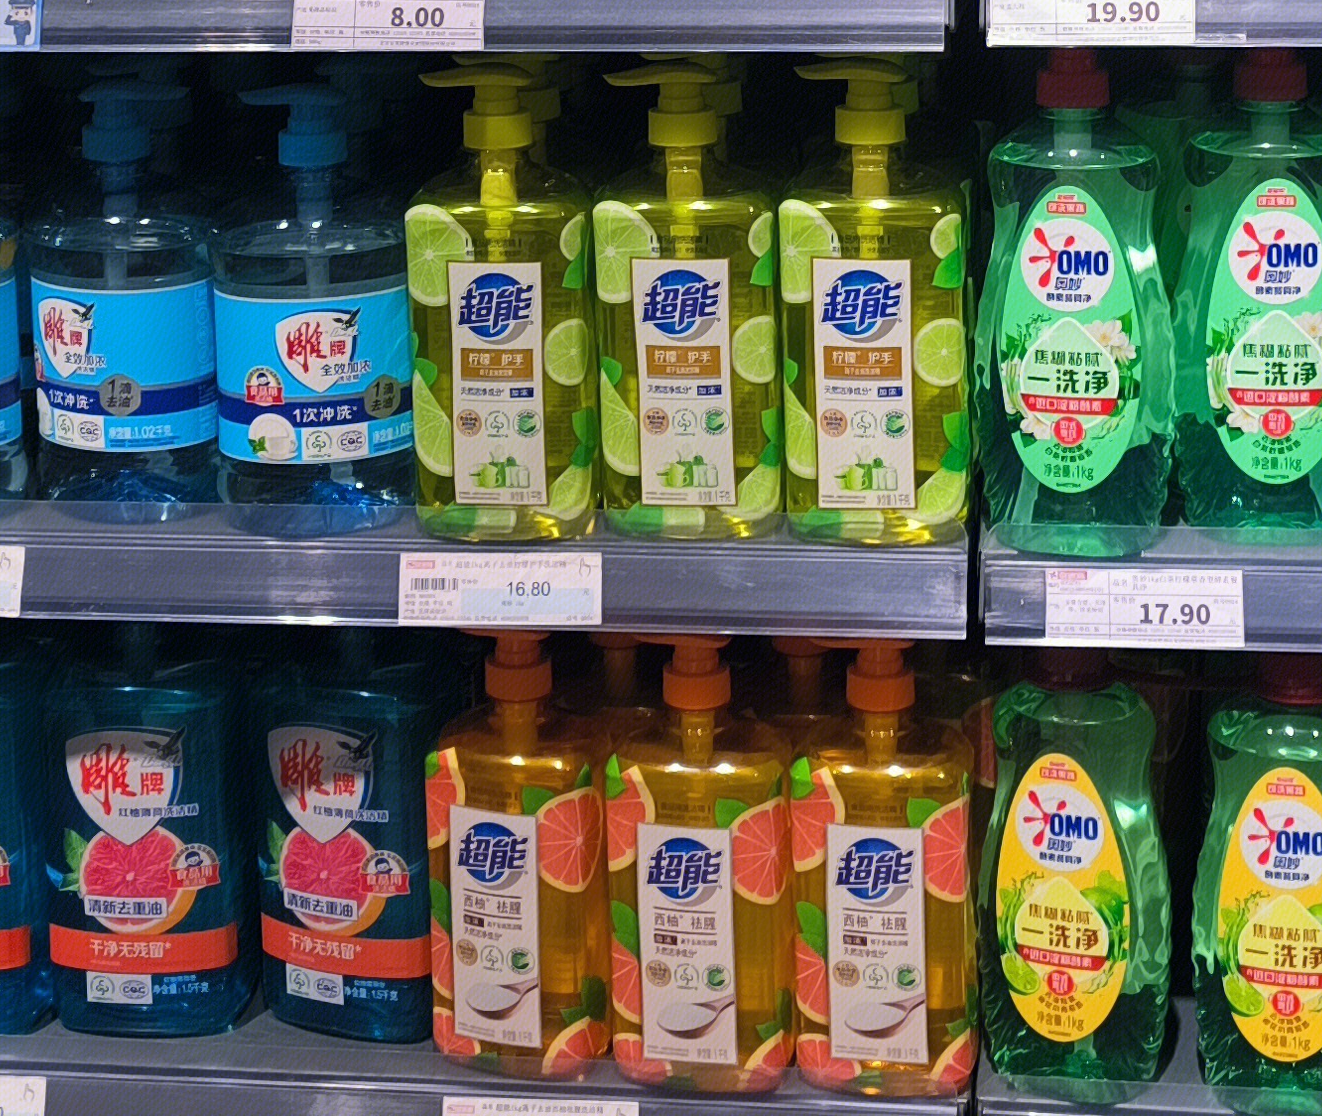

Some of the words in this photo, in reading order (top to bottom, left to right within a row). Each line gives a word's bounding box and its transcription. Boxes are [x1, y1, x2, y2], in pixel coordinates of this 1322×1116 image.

[391, 7, 444, 27] 8.00
[1087, 1, 1160, 23] 19.90
[1057, 250, 1109, 276] OMO
[642, 281, 721, 328] 超能
[1028, 369, 1110, 394] 一洗净
[507, 582, 550, 597] 16.80
[1140, 603, 1210, 625] 17.90
[1049, 812, 1098, 841] OMO
[457, 833, 528, 871] 超能
[835, 849, 913, 886] 超能
[287, 895, 353, 918] 清新去重油
[1022, 925, 1099, 950] 一洗净
